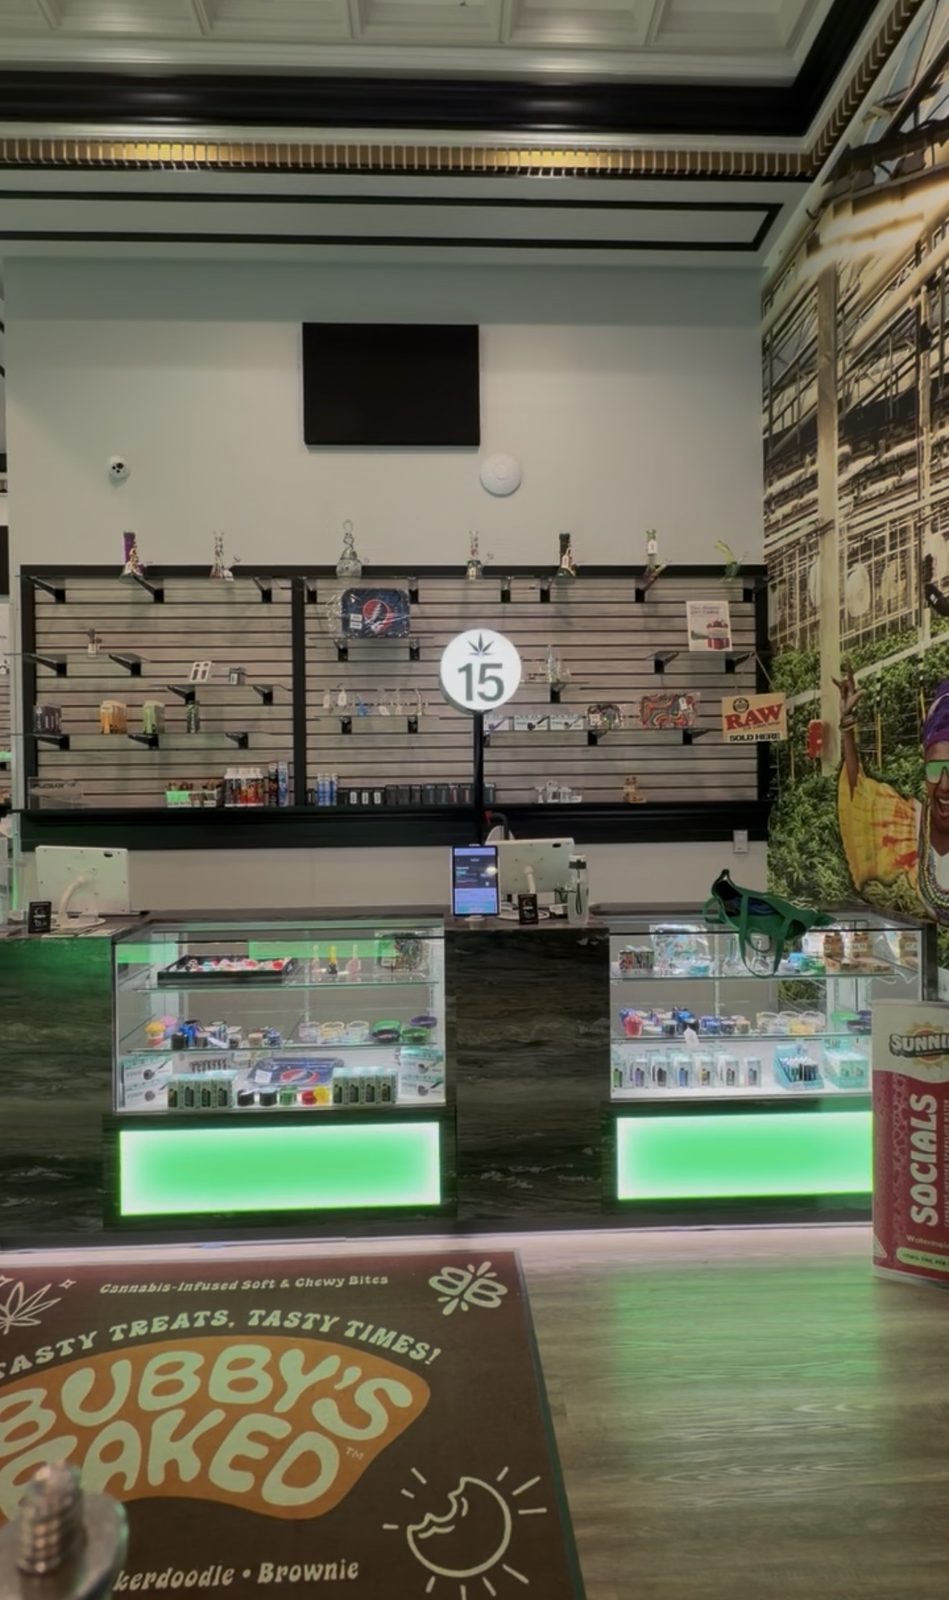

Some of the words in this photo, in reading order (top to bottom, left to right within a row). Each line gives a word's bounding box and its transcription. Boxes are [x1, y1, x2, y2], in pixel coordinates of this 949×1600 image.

[457, 662, 505, 702] 15
[725, 703, 784, 731] RAW
[729, 733, 754, 742] SOLD
[756, 732, 780, 740] HERE
[890, 1033, 949, 1052] SUNNI
[910, 1094, 939, 1227] SOCIALS
[99, 1280, 239, 1295] Cannabis-Infused
[241, 1279, 276, 1291] Soft
[280, 1279, 291, 1289] &
[295, 1275, 345, 1288] Chewy
[348, 1274, 389, 1286] Bites
[248, 1309, 340, 1334] TASTY
[344, 1317, 443, 1366] TIMES!
[0, 1344, 414, 1458] BUBBY'S
[257, 1558, 360, 1584] Brownie
